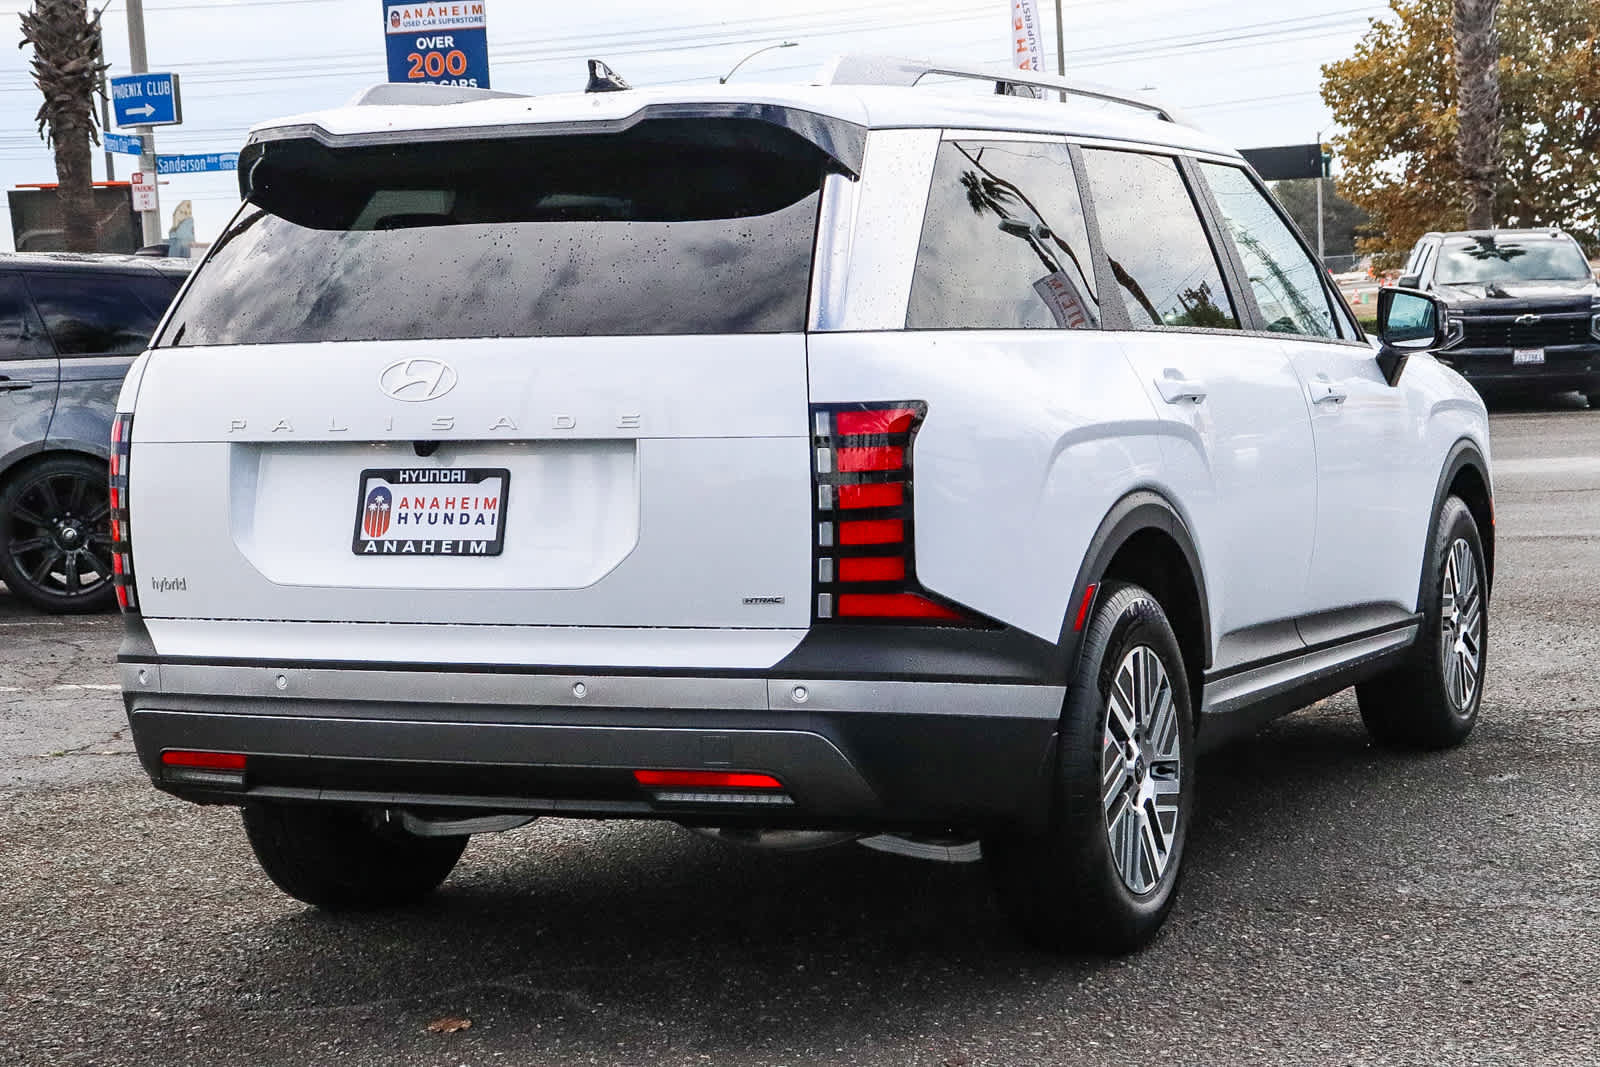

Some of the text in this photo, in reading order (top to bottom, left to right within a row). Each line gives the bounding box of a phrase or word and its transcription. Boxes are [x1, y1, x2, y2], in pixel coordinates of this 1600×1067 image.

[403, 4, 483, 19] ANAHEIM
[402, 15, 483, 27] USED CAR SUPERSTORE
[416, 35, 454, 49] OVER
[407, 49, 467, 78] 200
[112, 80, 170, 99] PHOENIX CLUB
[158, 155, 218, 173] Sanderson Ave
[227, 412, 641, 433] PALISADE
[400, 470, 466, 482] HYUNDAI
[399, 497, 497, 510] ANAHEIM
[397, 512, 496, 525] HYUNDAI
[364, 540, 487, 553] ANAHEIM
[152, 577, 186, 592] hybrid
